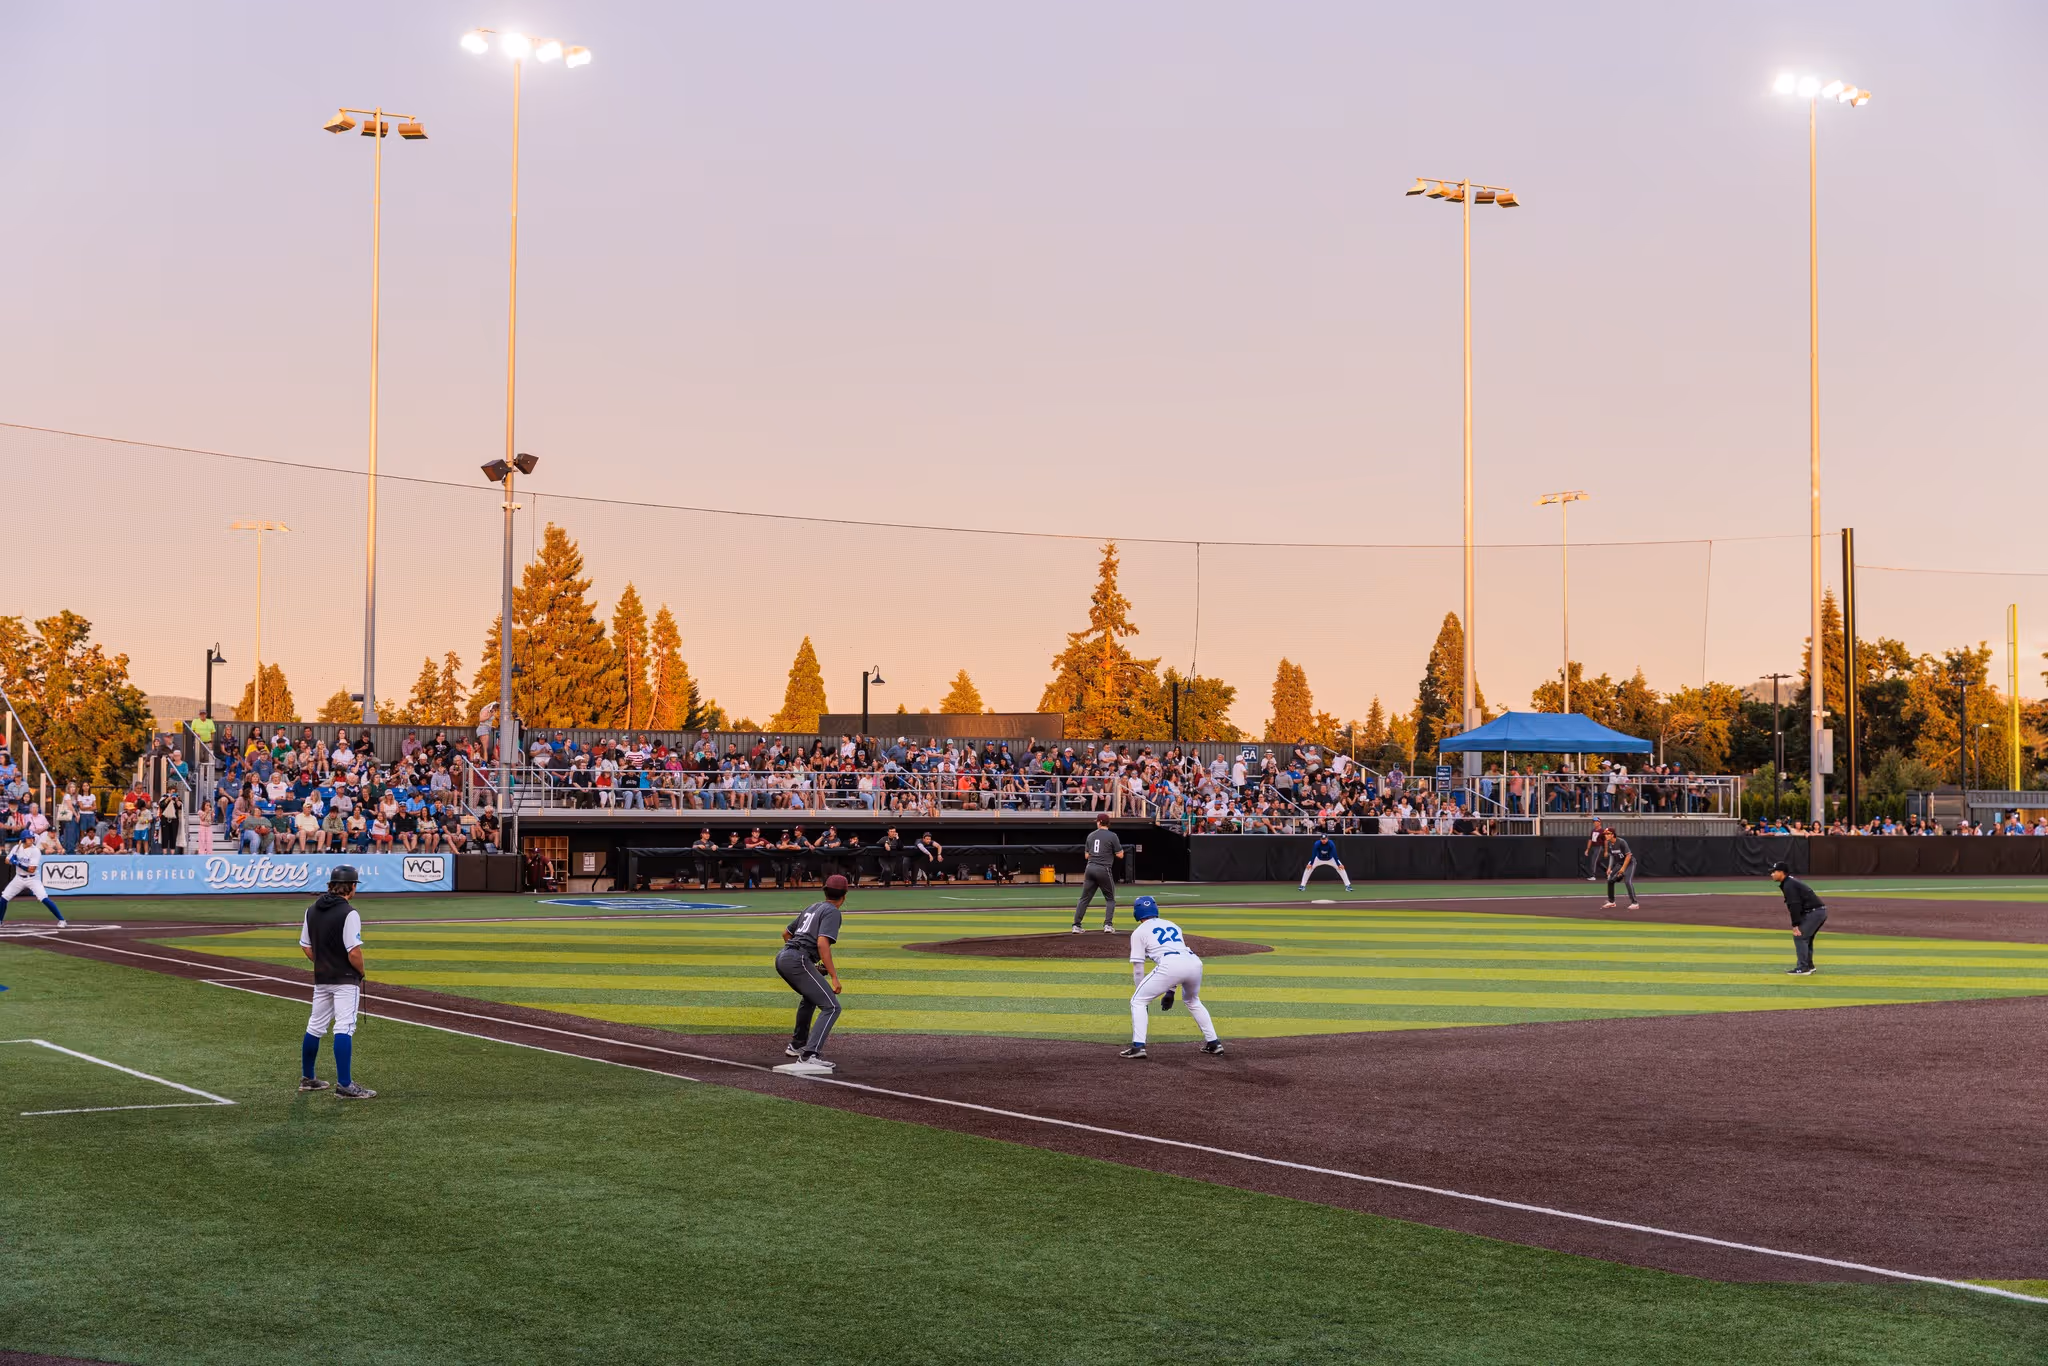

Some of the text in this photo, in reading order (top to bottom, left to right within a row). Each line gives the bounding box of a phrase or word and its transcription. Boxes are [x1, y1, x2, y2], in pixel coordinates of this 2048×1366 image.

[1242, 750, 1257, 760] GA
[1093, 839, 1101, 853] 8
[45, 865, 85, 880] WCL
[101, 856, 380, 890] SPRINGFIELD Drifters BAALL
[406, 859, 441, 874] WCL
[1152, 926, 1183, 945] 22
